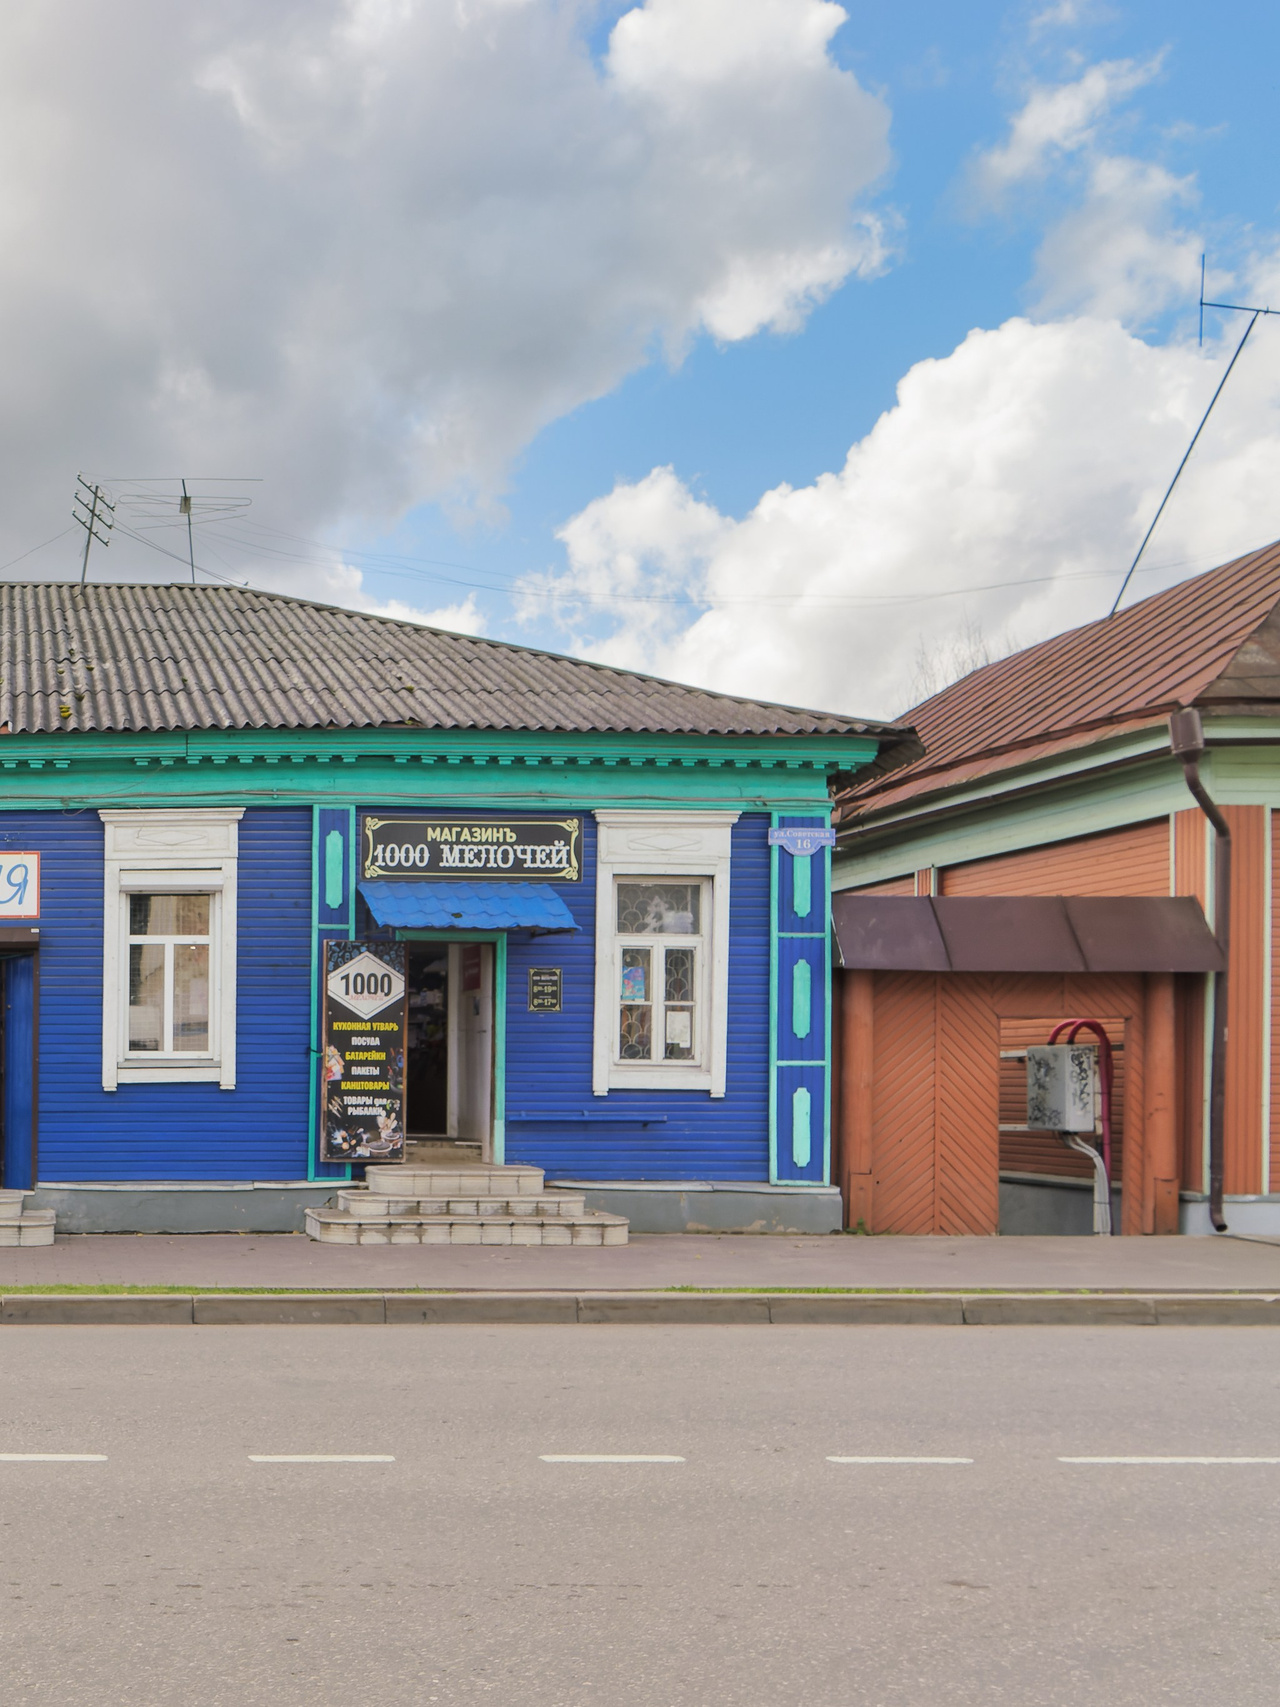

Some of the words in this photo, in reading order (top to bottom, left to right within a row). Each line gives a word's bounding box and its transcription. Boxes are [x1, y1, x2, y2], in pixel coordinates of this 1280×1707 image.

[426, 827, 517, 842] МАГАЗИНЪ
[796, 839, 811, 849] 16
[374, 843, 430, 867] 1000
[439, 840, 570, 868] МЕЛОЧЕЙ
[340, 972, 392, 997] 1000
[333, 1022, 371, 1031] КУХОННАЯ
[372, 1022, 399, 1032] УТВАРЬ
[351, 1036, 380, 1046] ПОСУДА
[345, 1050, 386, 1060] БАТАРЕЙКИ
[351, 1066, 380, 1075] ПАКЕТЫ
[341, 1081, 390, 1090] КАНЦТОВАРЫ
[343, 1095, 373, 1105] ТОВАРЫ
